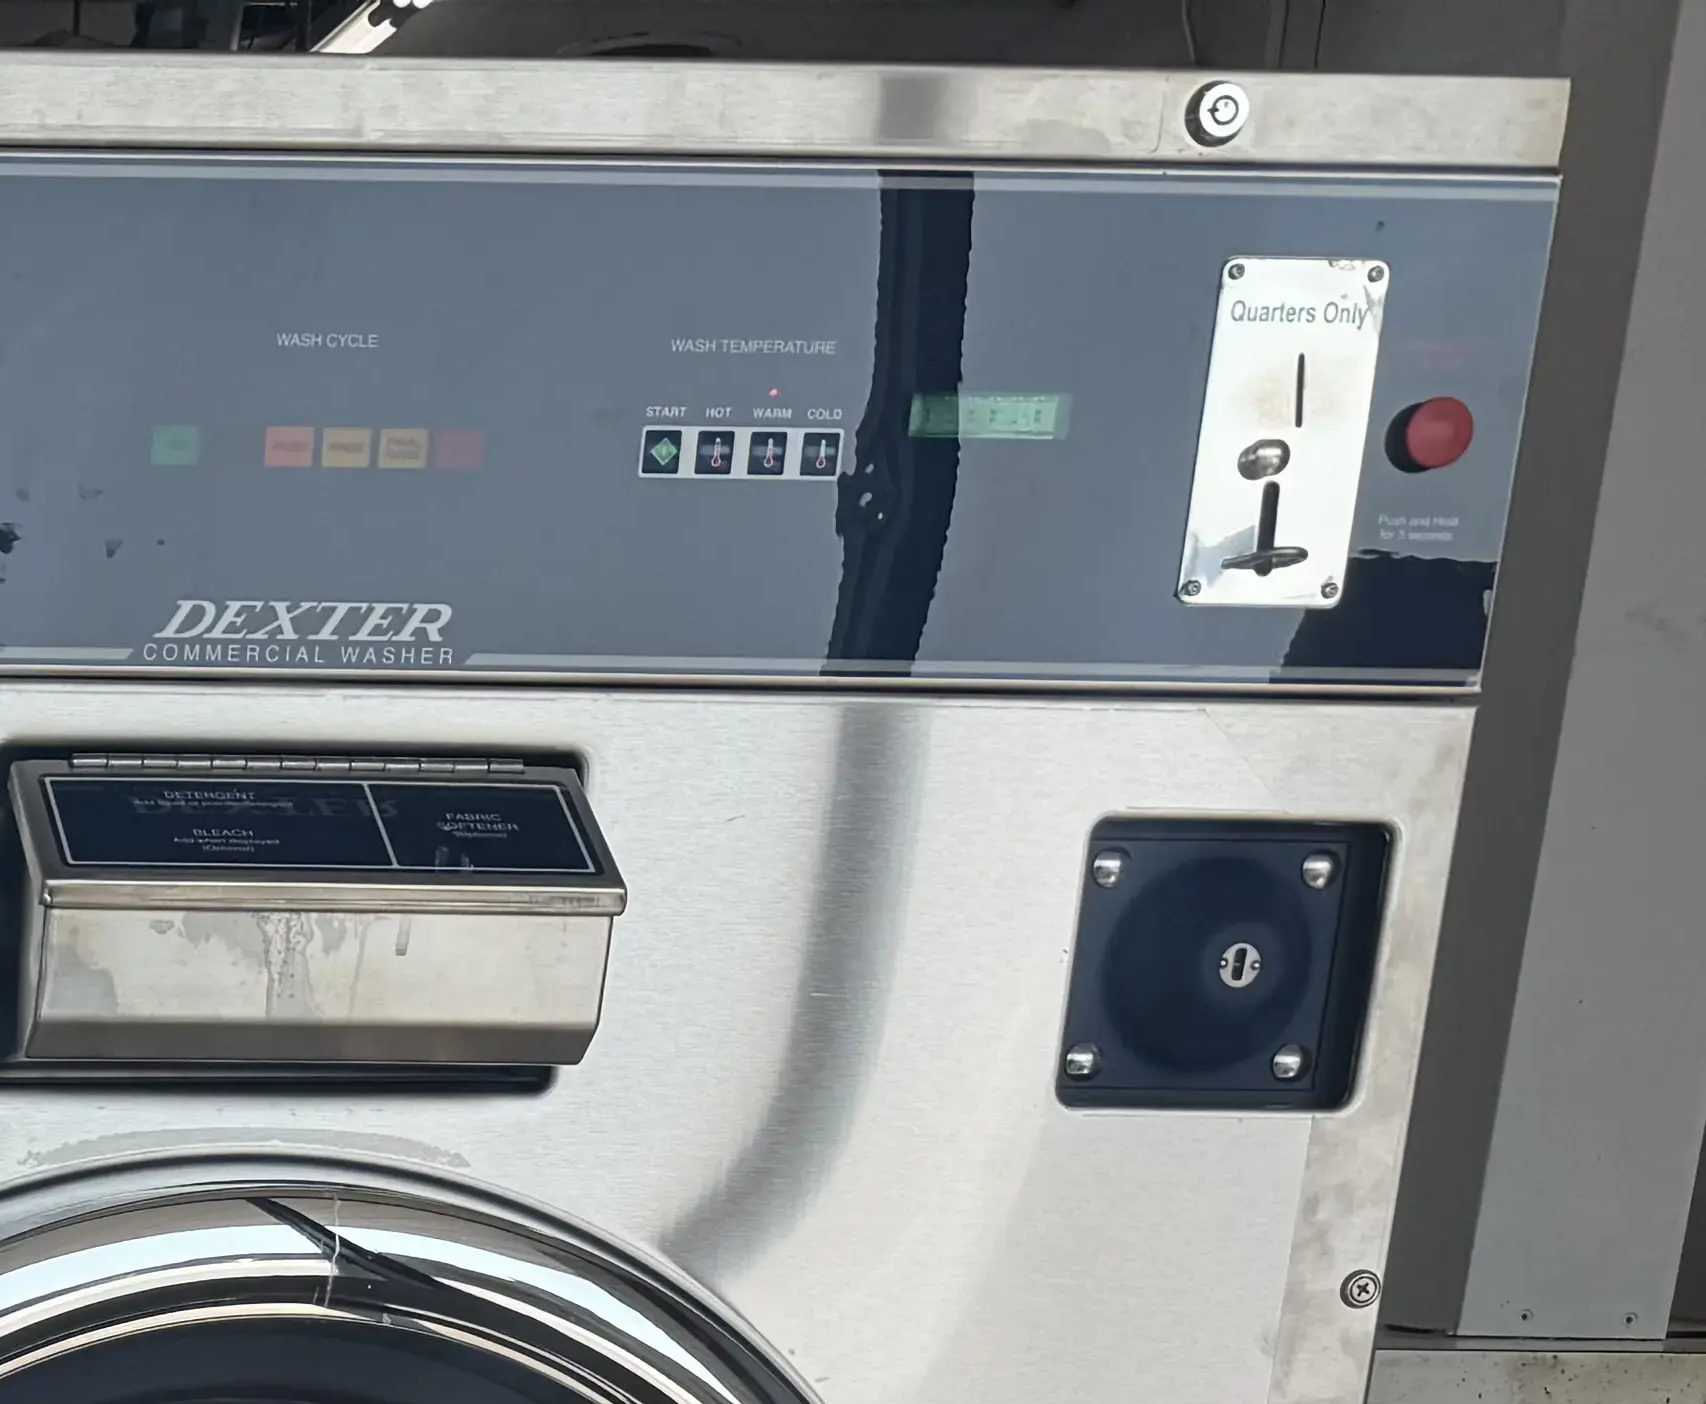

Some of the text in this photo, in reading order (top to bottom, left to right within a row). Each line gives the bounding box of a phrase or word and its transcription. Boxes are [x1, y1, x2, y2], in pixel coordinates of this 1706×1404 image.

[1230, 299, 1369, 330] Quarters Only
[276, 333, 379, 347] WASH CYCLE
[670, 338, 836, 355] WASH TEMPERATURE
[646, 407, 686, 418] START
[705, 407, 731, 418] HOT
[753, 407, 792, 419] WARM
[807, 408, 842, 419] COLD
[153, 600, 453, 642] DEXTER
[143, 643, 453, 665] COMMERCIAL WASHER
[446, 813, 501, 821] FABRIC
[437, 822, 519, 831] SOFTENER
[193, 828, 254, 837] BLEACH
